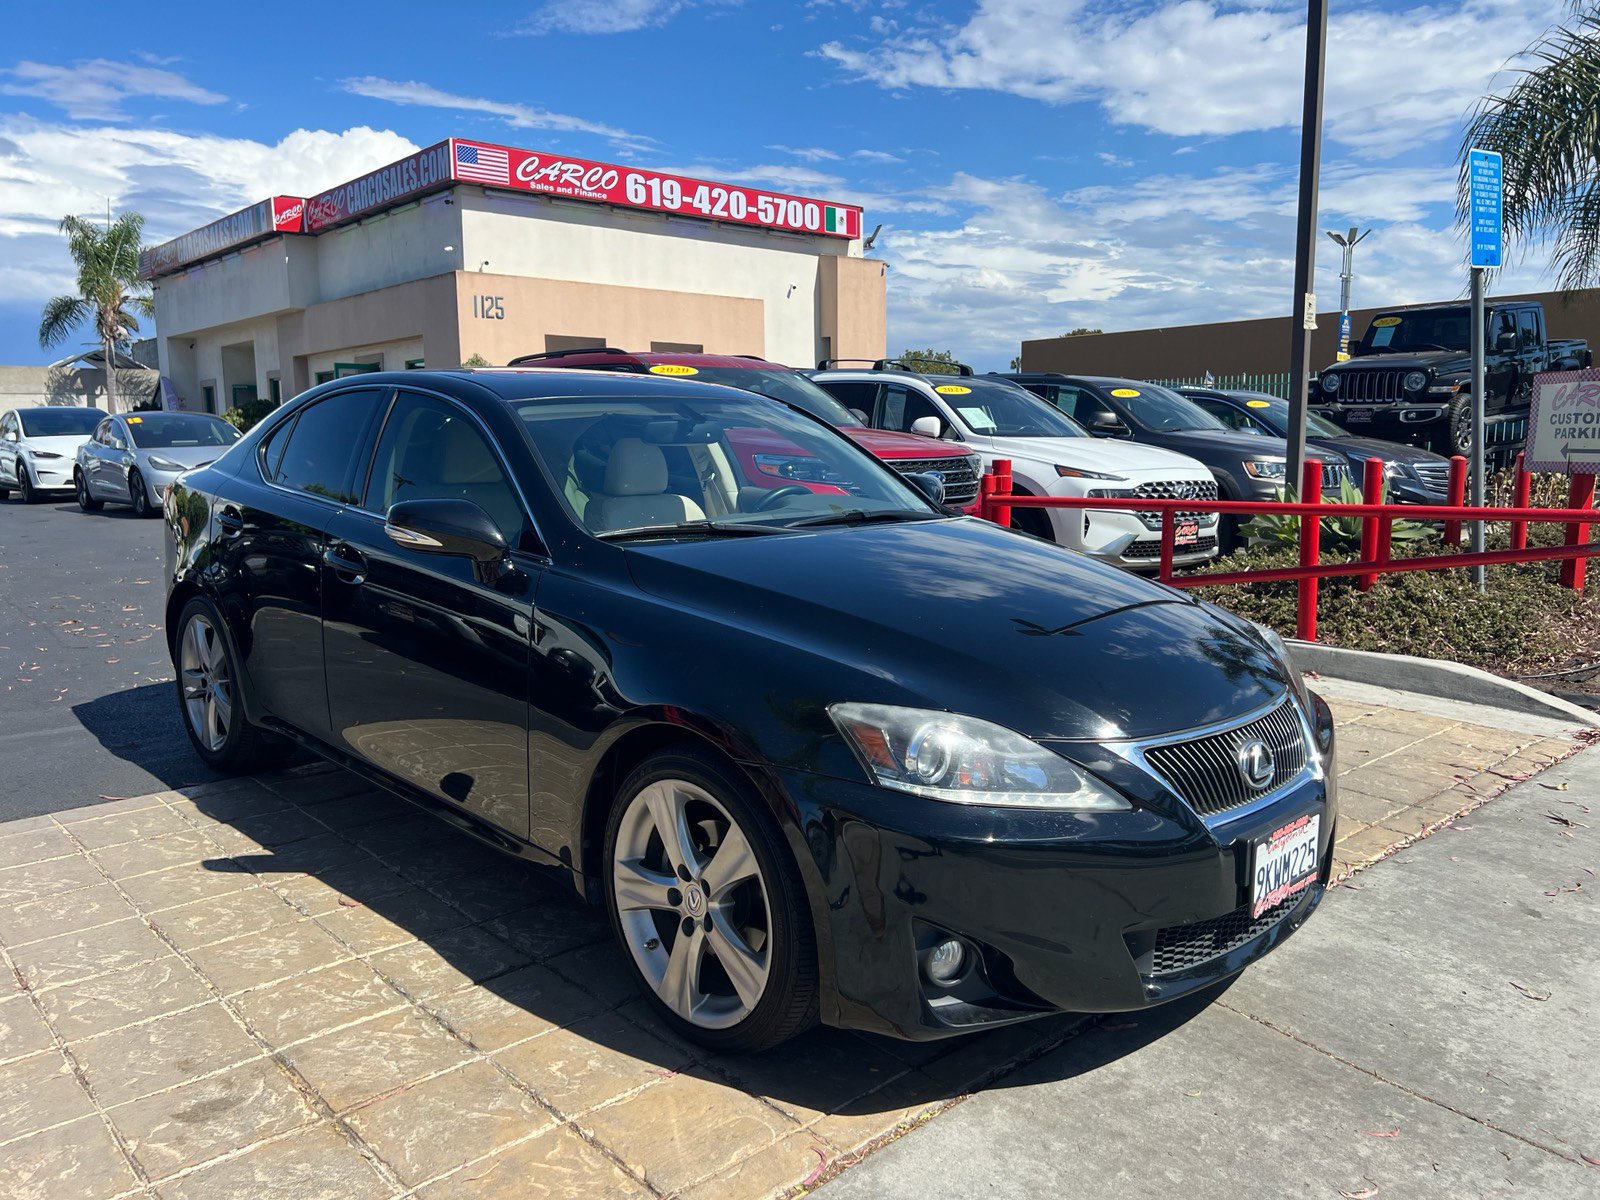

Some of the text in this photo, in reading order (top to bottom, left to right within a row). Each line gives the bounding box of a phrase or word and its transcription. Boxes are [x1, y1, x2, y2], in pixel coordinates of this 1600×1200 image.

[346, 145, 450, 214] CARCOSALES.COM
[516, 156, 619, 191] CARCO
[530, 181, 607, 199] Sales and Finance
[275, 204, 302, 224] CARCO
[308, 187, 345, 225] CARCO
[625, 172, 820, 231] 619-420-5700
[474, 295, 505, 320] 1125
[659, 366, 689, 374] 2020
[1257, 836, 1316, 900] 9KWM225
